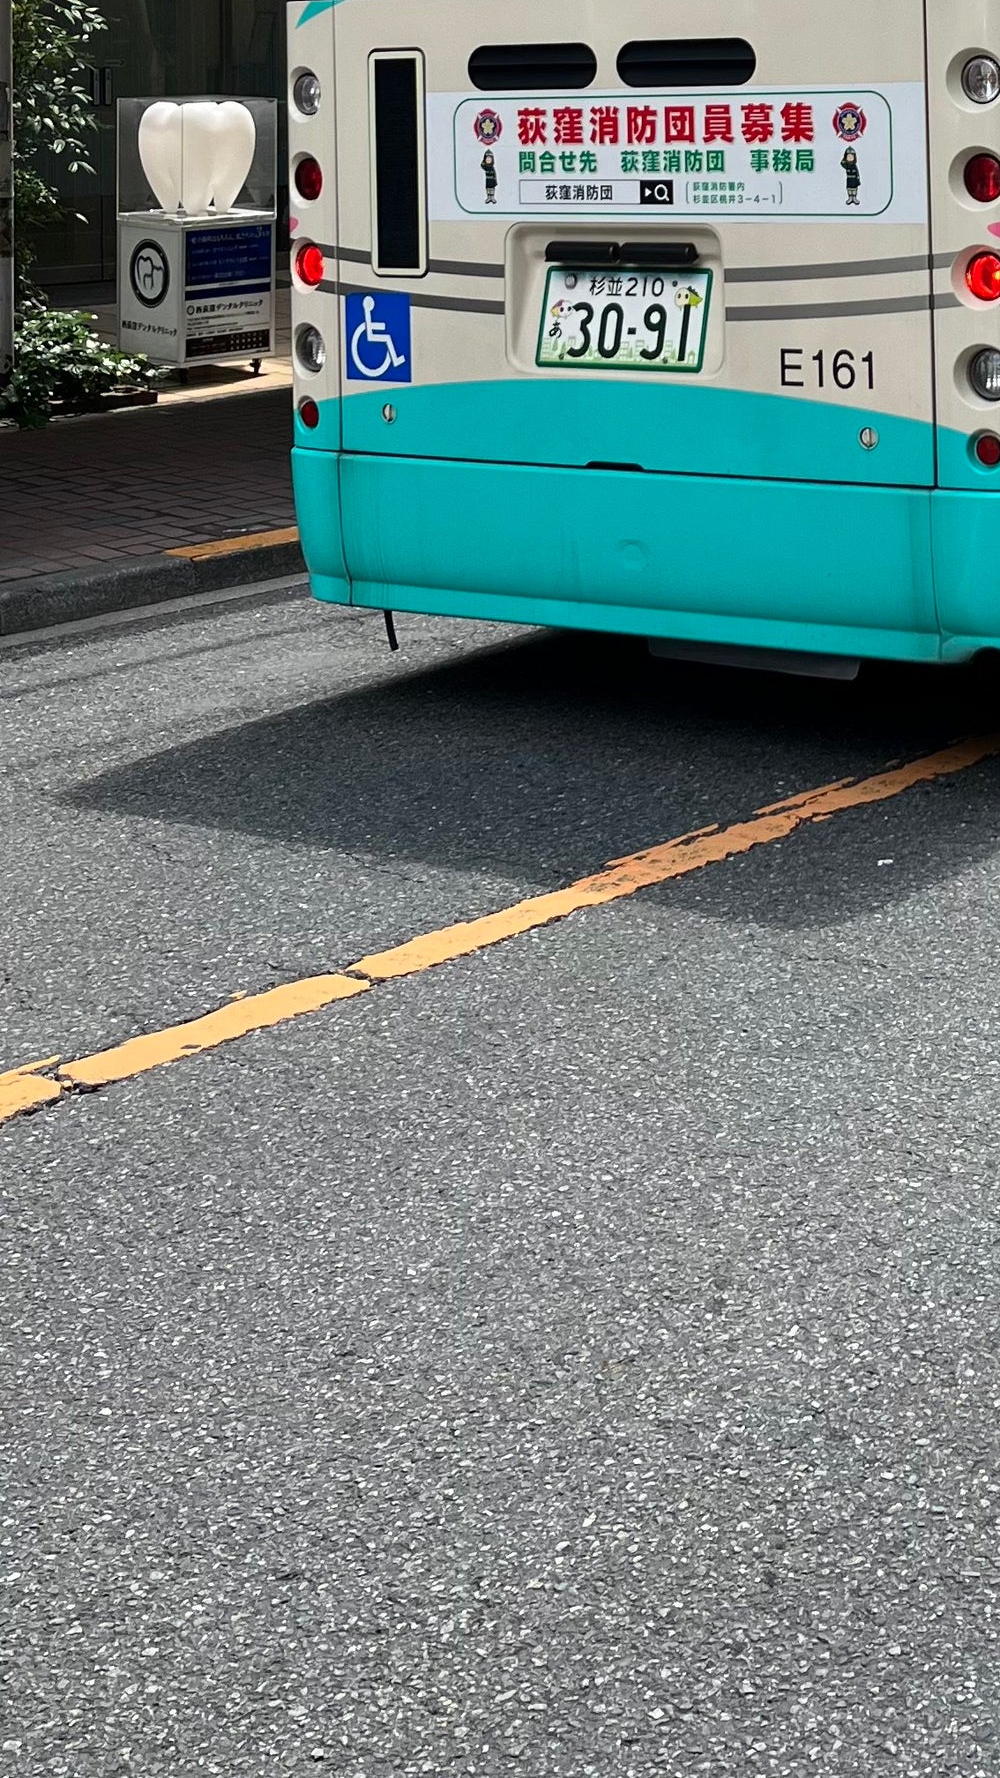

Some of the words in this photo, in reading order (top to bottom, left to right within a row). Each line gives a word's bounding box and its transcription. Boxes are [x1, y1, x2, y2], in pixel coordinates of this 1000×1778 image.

[516, 102, 815, 145] 荻窪消防団員募集
[518, 150, 598, 174] 問合せ先
[620, 150, 726, 173] 荻窪消防団
[749, 149, 815, 173] 事務局
[545, 184, 613, 201] 荻窪消防団
[692, 181, 745, 192] 荻窪消防署内
[589, 275, 665, 297] 杉並210
[548, 320, 563, 339] あ
[566, 301, 692, 362] 30-91
[779, 347, 875, 390] E161
